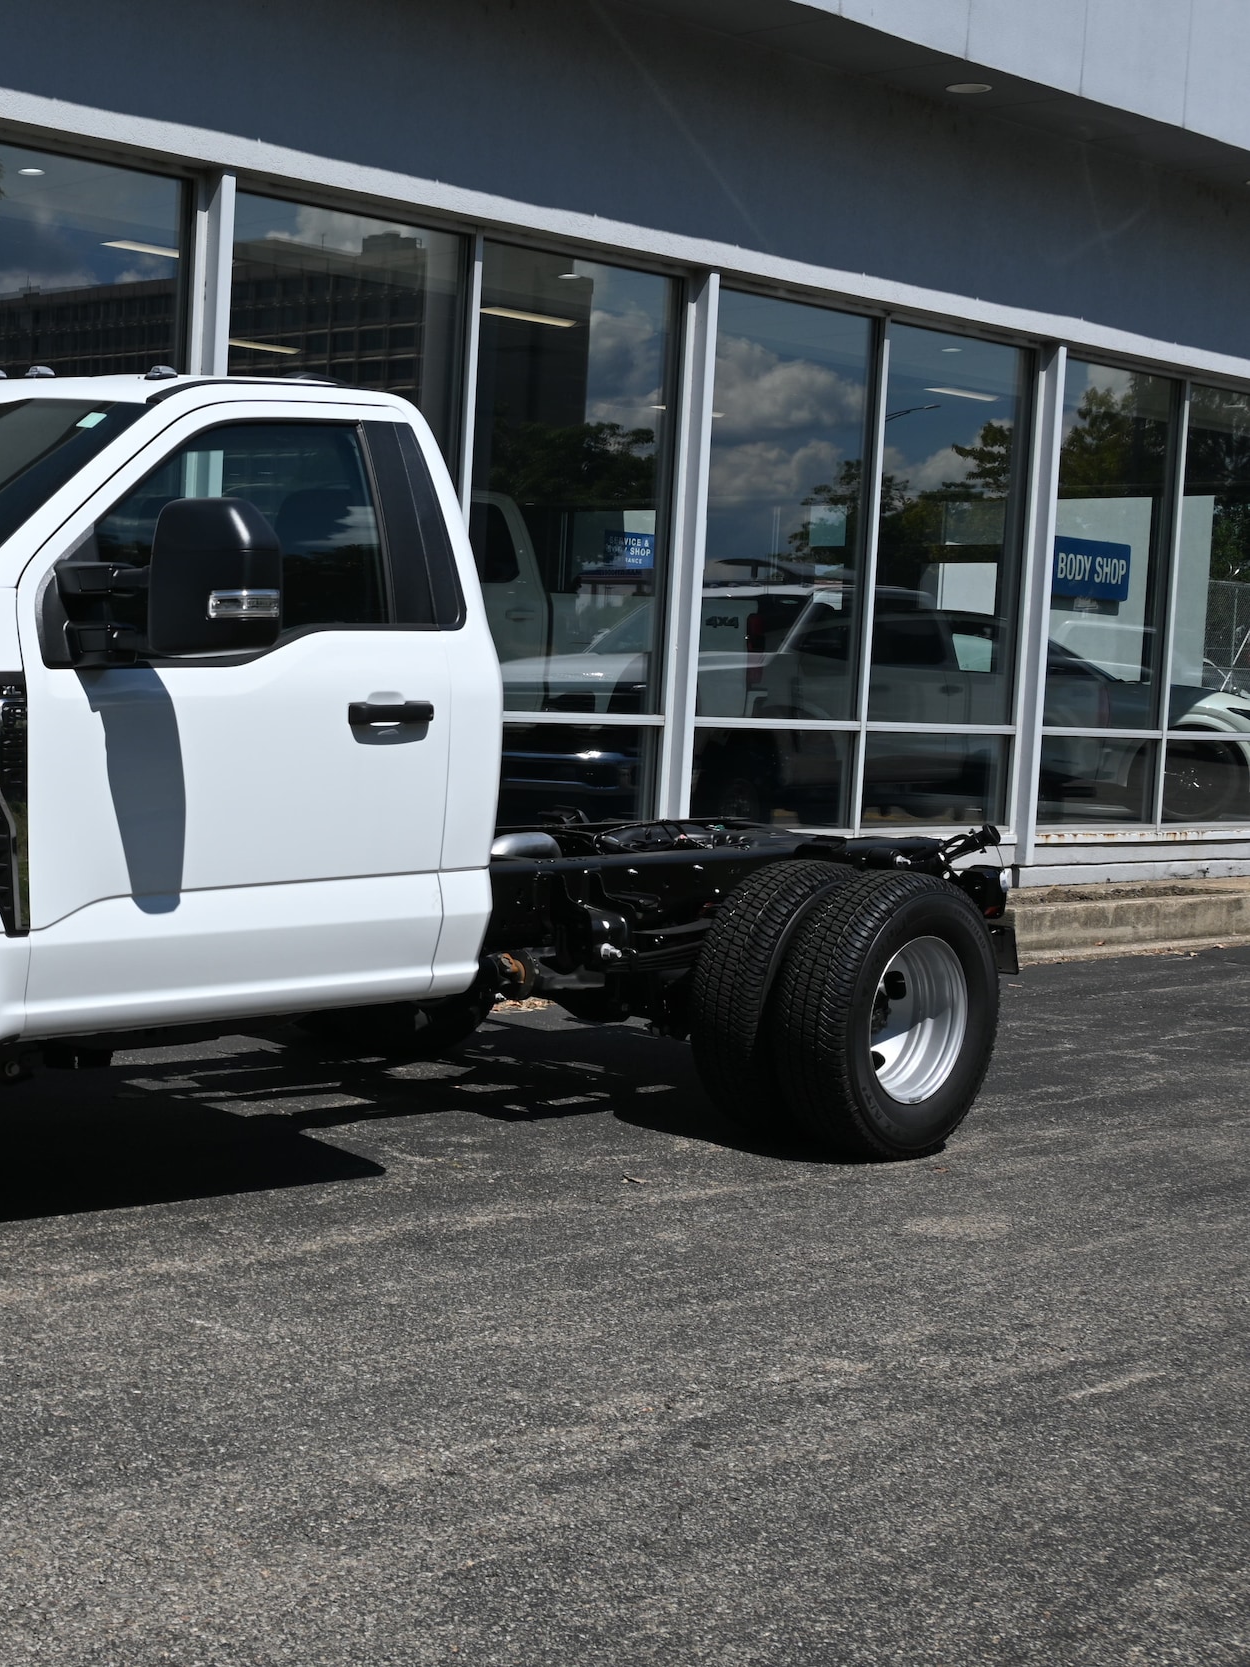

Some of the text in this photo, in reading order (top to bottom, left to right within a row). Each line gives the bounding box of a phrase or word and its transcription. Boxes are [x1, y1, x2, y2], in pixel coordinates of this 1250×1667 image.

[630, 547, 651, 556] SHOP
[1057, 552, 1127, 585] BODY SHOP
[2, 685, 22, 696] XL
